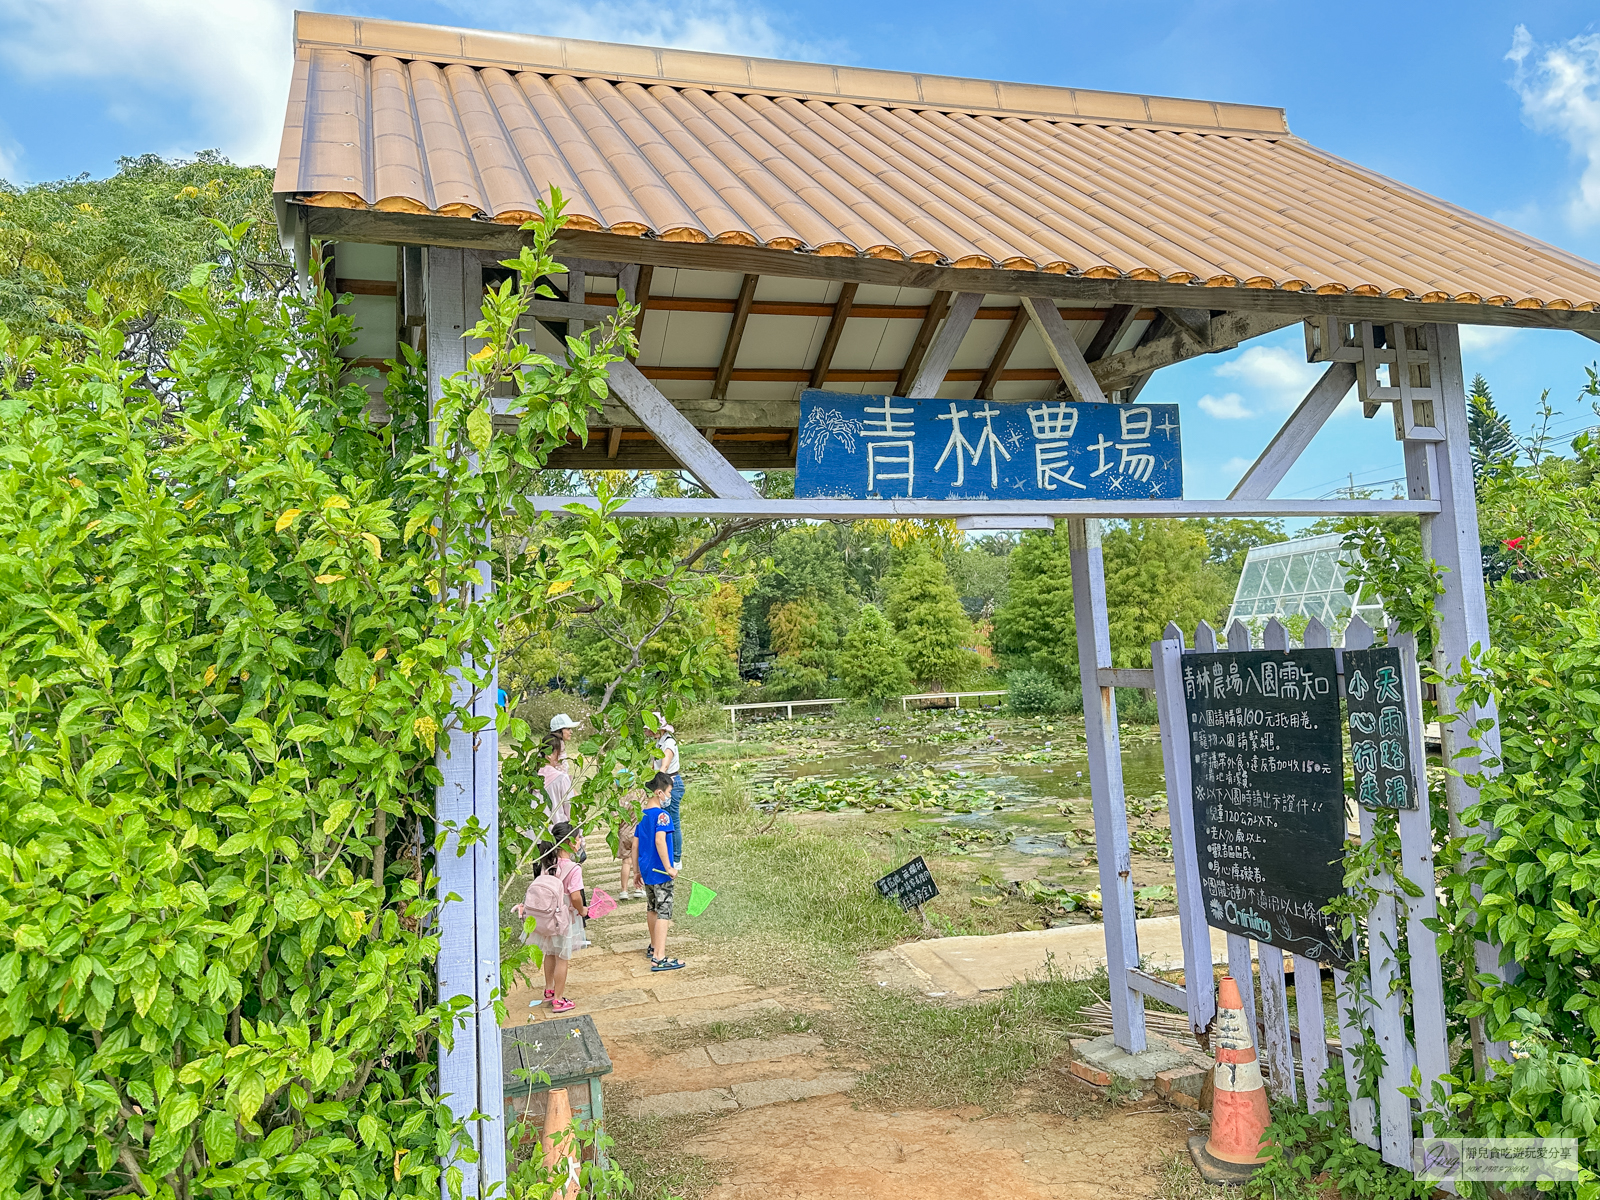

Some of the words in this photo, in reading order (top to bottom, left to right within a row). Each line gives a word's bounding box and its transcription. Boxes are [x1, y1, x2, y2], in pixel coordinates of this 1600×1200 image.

[859, 396, 1156, 497] 青林農場
[1184, 661, 1329, 700] 青林農場入園需知
[1349, 670, 1382, 805] 小心行走
[1374, 666, 1408, 808] 天雨路滑
